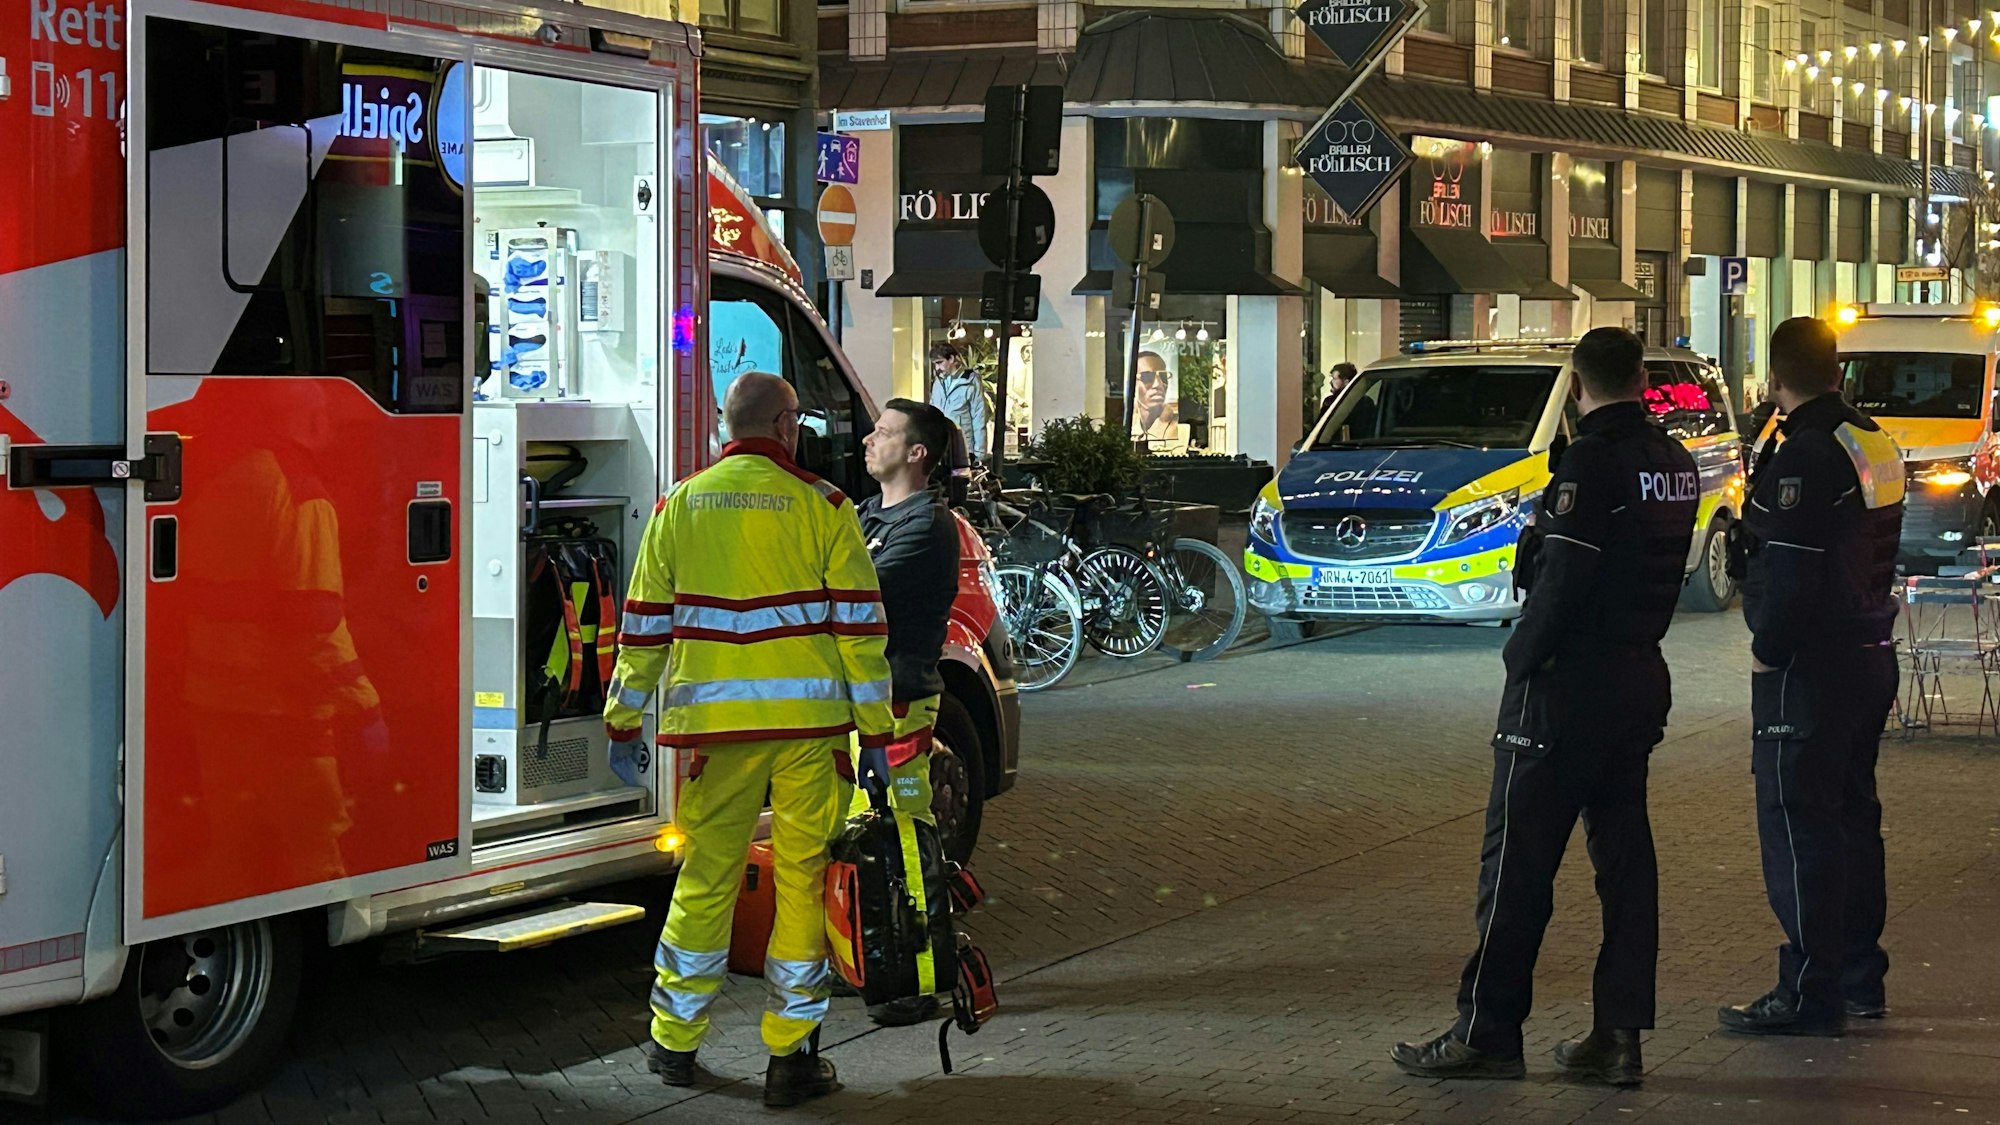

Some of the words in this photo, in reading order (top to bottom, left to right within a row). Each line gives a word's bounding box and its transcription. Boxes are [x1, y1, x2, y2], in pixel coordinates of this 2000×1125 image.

[31, 0, 121, 50] Rett
[1329, 144, 1371, 155] BRILLEN
[1727, 262, 1742, 290] P
[1315, 470, 1423, 484] POLIZEI
[1639, 471, 1697, 501] POLIZEI
[687, 491, 795, 512] RETTUNGSDIENST
[631, 508, 639, 520] 4
[1320, 570, 1340, 584] NRW
[1346, 570, 1389, 584] 4-7061
[1506, 735, 1531, 746] POLIZEI
[428, 842, 455, 857] WAS
